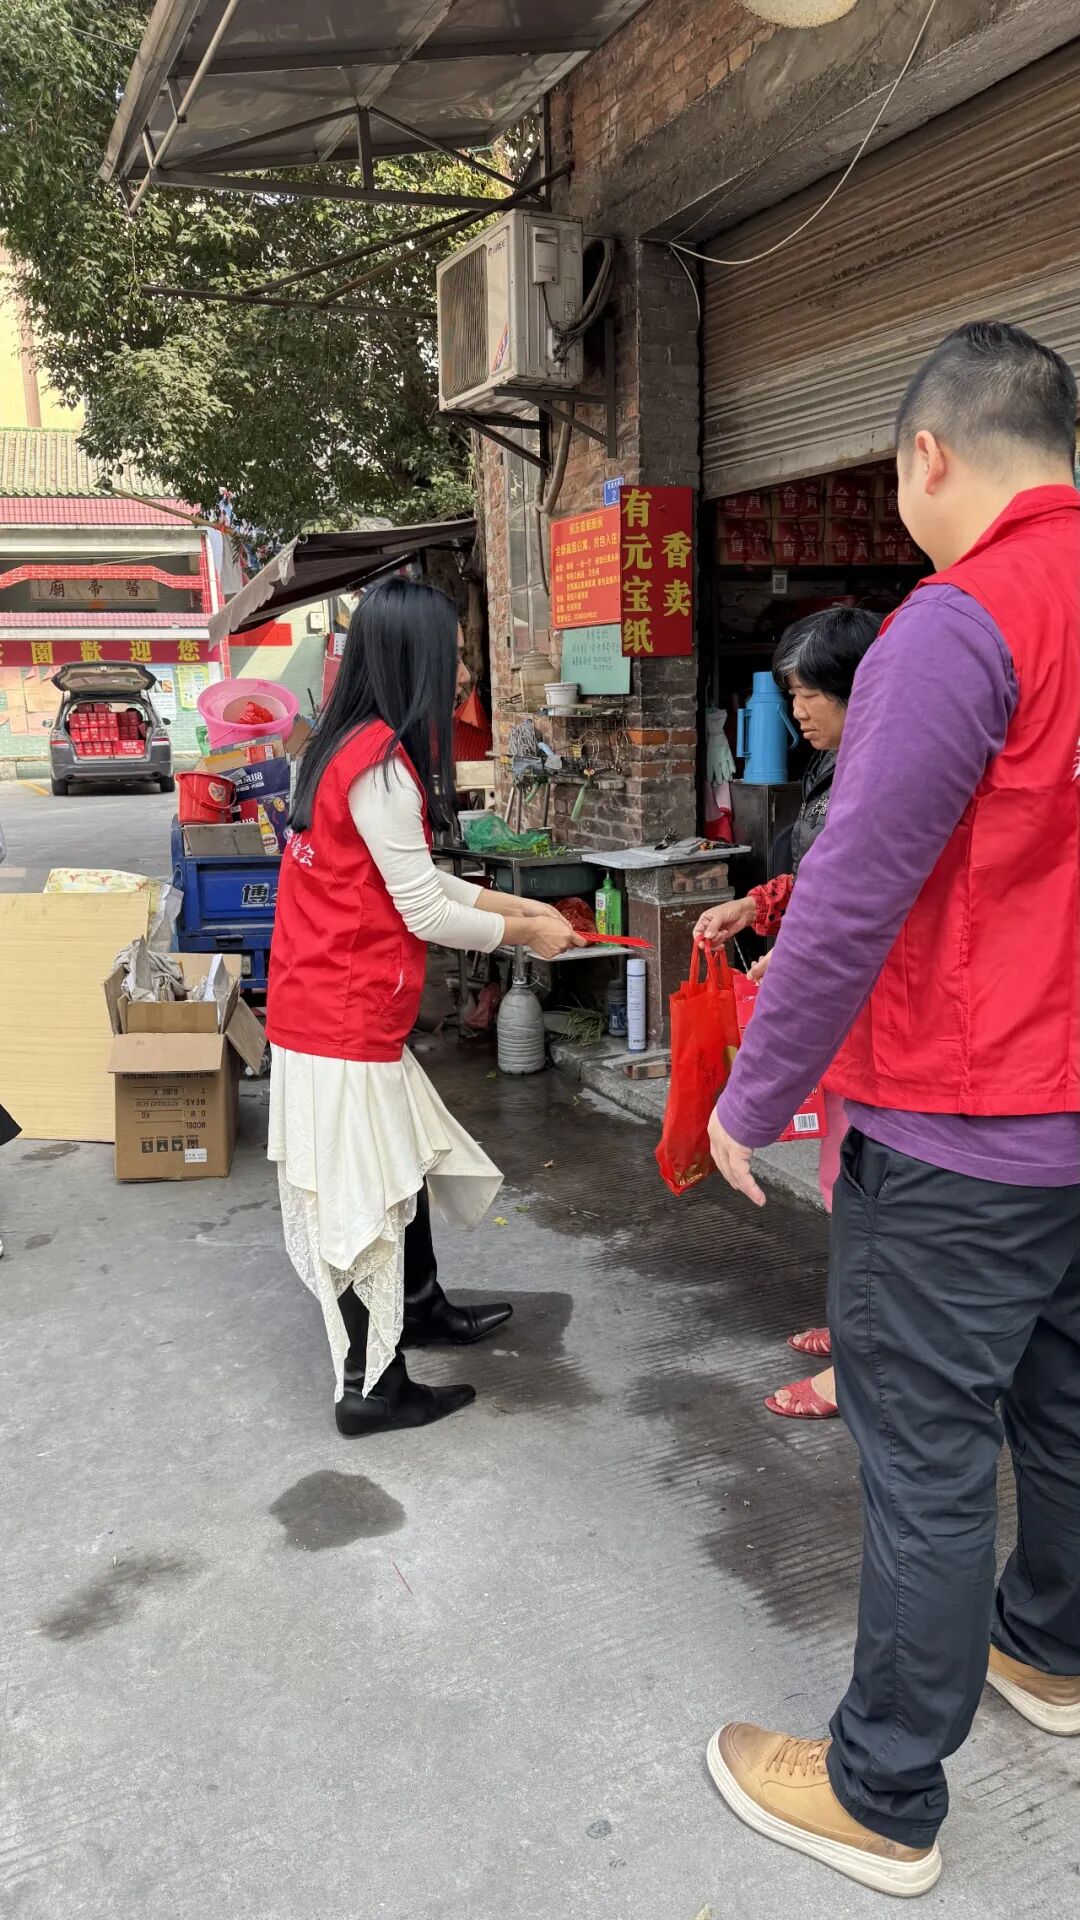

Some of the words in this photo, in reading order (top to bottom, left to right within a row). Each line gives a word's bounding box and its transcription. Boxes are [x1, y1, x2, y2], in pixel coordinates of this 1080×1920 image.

[622, 488, 654, 655] 有元宝纸
[661, 530, 693, 617] 香卖
[0, 640, 201, 664] 園歡迎您
